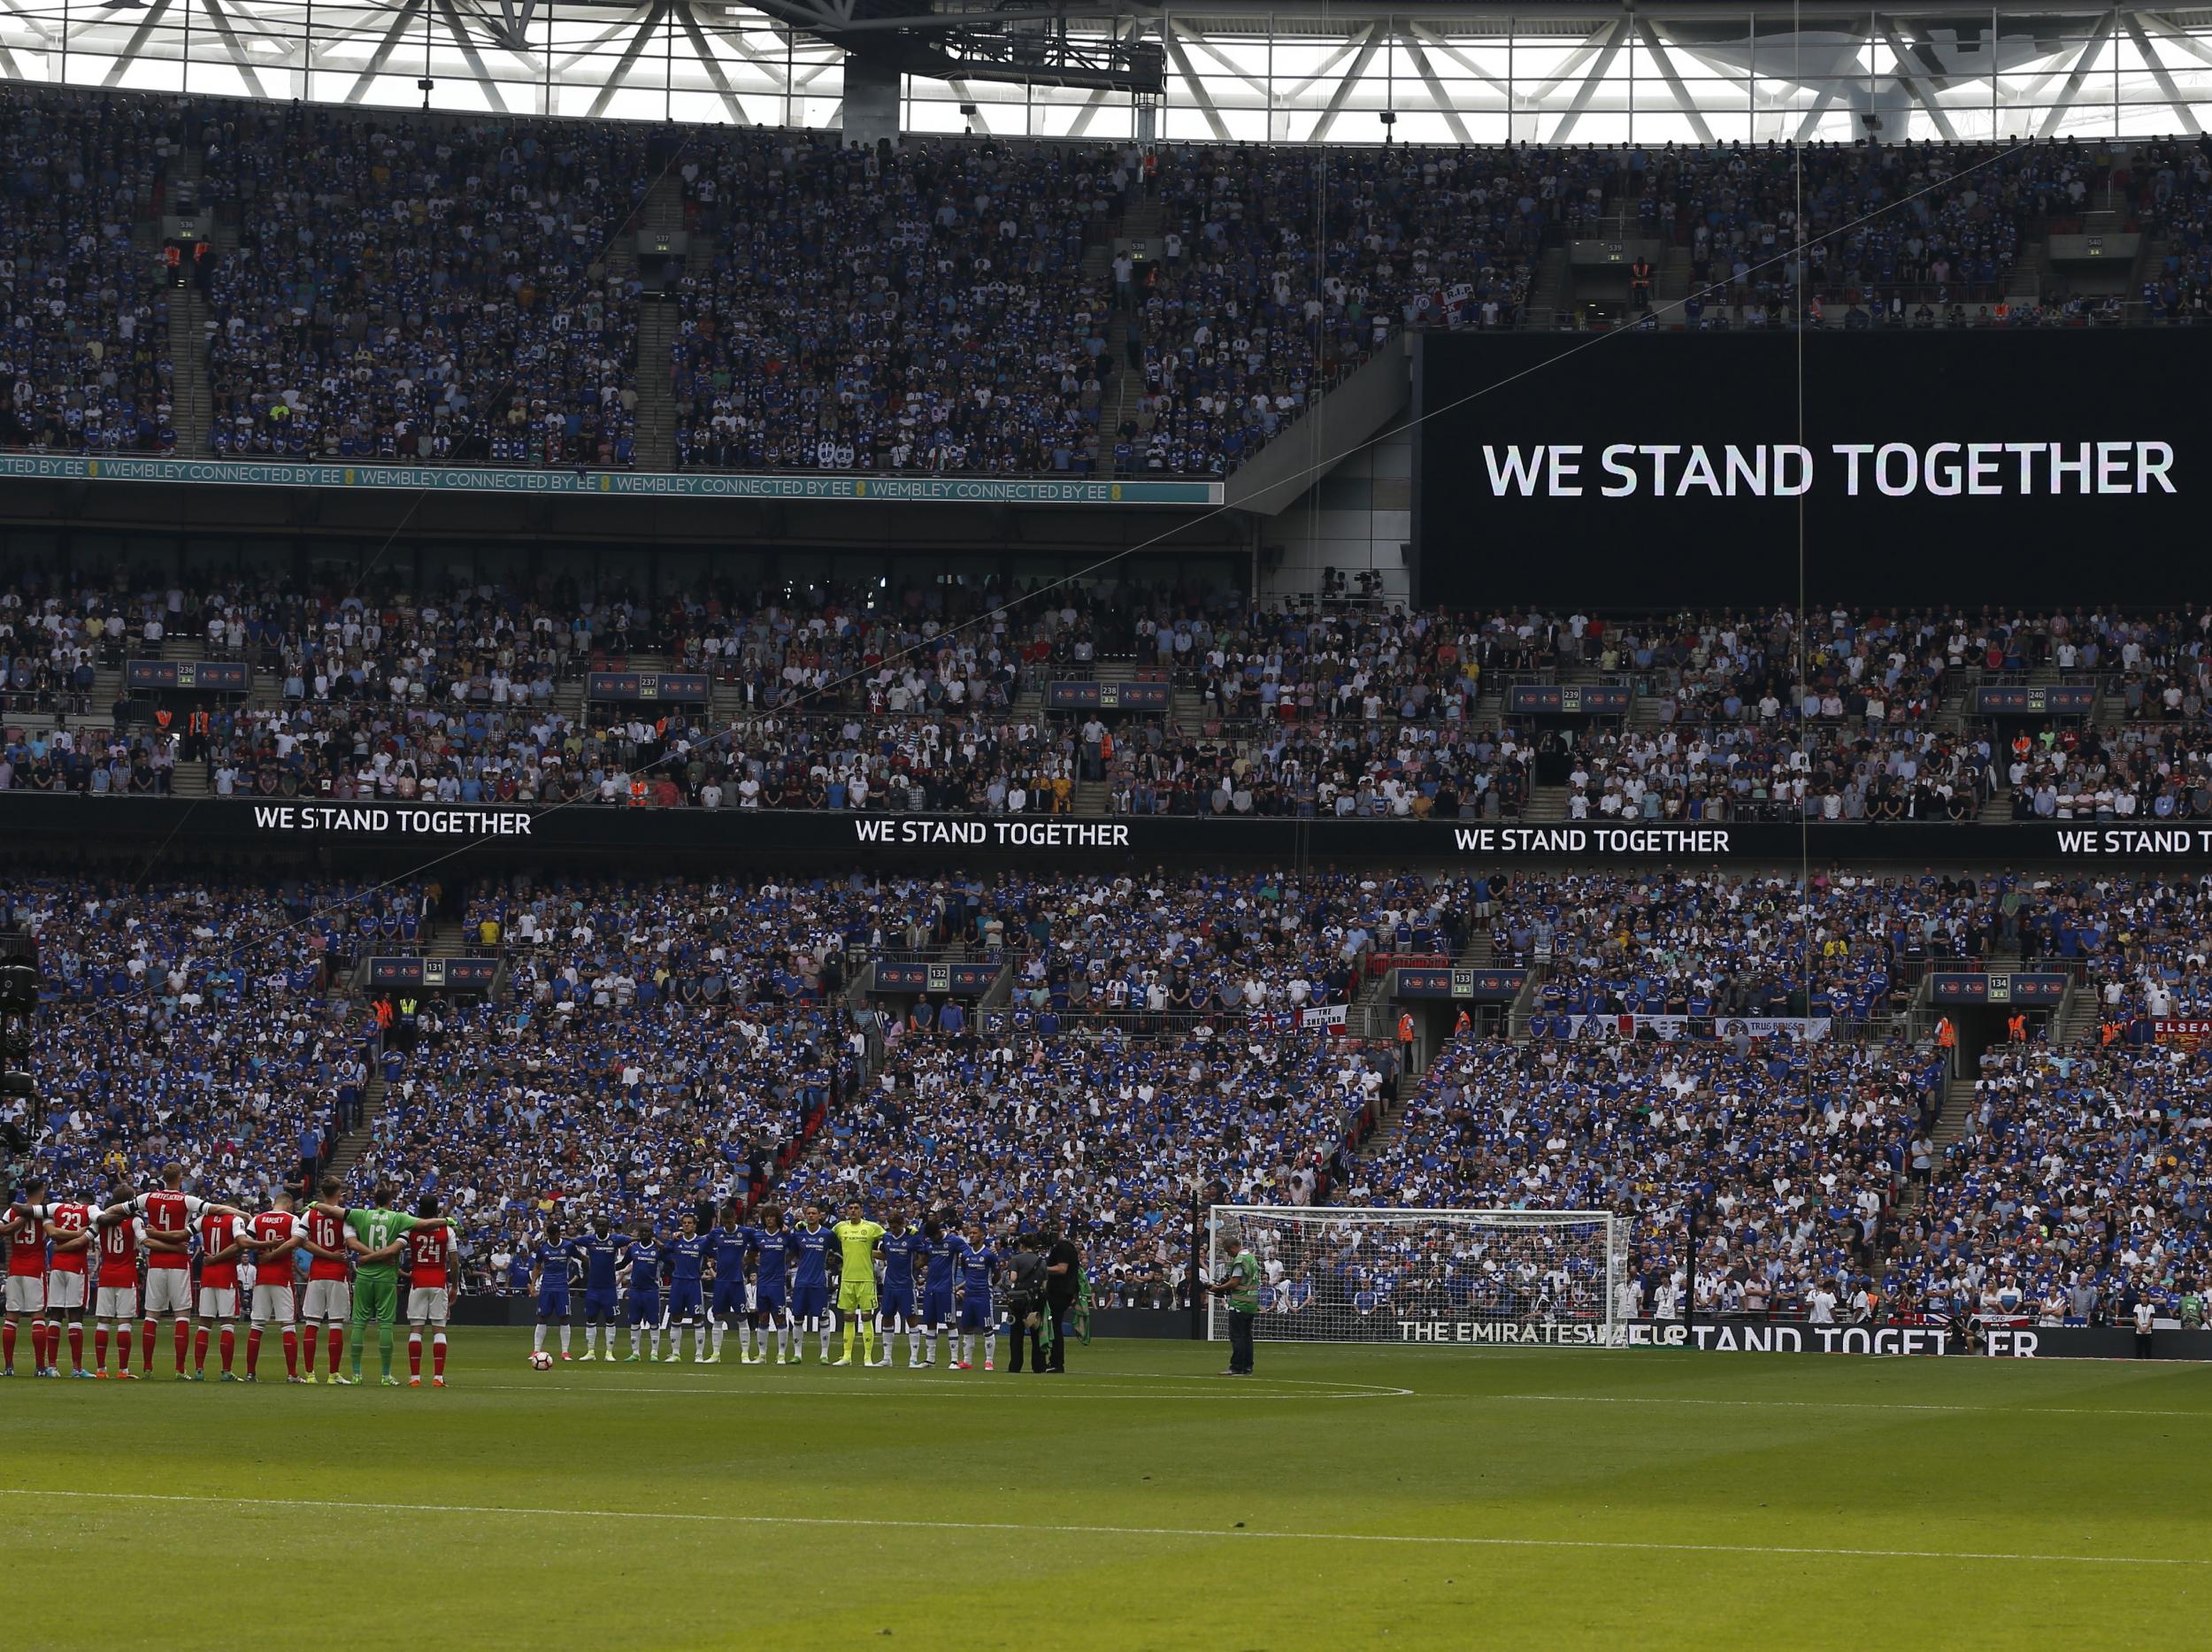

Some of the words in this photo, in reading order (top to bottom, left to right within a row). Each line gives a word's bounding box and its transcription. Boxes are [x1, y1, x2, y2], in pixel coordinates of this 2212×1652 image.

[40, 460, 62, 474] BY
[65, 461, 84, 475] EE
[105, 463, 186, 479] WEMBLEY
[189, 465, 292, 482] CONNECTED
[296, 467, 319, 482] BY
[321, 468, 341, 483] EE
[1483, 446, 1583, 496] WE
[1601, 444, 1813, 497] STAND
[1832, 442, 2177, 496] TOGETHER
[361, 469, 442, 487] WEMBLEY
[445, 473, 548, 489] CONNECTED
[551, 475, 572, 490] BY
[577, 476, 595, 491] EE
[618, 478, 698, 493] WEMBLEY
[702, 479, 803, 496] CONNECTED
[806, 481, 828, 496] BY
[832, 482, 851, 496] EE
[872, 483, 952, 498] WEMBLEY
[956, 484, 1058, 500] CONNECTED
[1062, 486, 1084, 500] BY
[1088, 486, 1107, 500] EE
[255, 807, 294, 828] WE
[302, 805, 388, 832] STAND
[396, 809, 531, 834] TOGETHER
[856, 819, 895, 843] WE
[902, 819, 986, 844] STAND
[994, 821, 1129, 847] TOGETHER
[1455, 828, 1494, 851] WE
[1502, 828, 1586, 852] STAND
[1594, 829, 1730, 852] TOGETHER
[2057, 831, 2098, 852] WE
[2105, 831, 2190, 852] STAND
[1992, 979, 2007, 987] 134
[1750, 1022, 1770, 1031] TRUE
[61, 1211, 82, 1232] 23
[159, 1204, 170, 1233] 4
[107, 1225, 124, 1254] 18
[211, 1227, 221, 1256] 11
[317, 1218, 335, 1248] 16
[368, 1224, 388, 1252] 13
[416, 1234, 441, 1263] 24
[612, 1305, 620, 1316] 15
[944, 1312, 952, 1323] 19
[983, 1317, 992, 1327] 10
[1397, 1321, 1449, 1341] THE
[1456, 1322, 1589, 1344] EMIRATES
[1636, 1325, 1688, 1346] CUP
[1814, 1327, 2039, 1357] TOGETER
